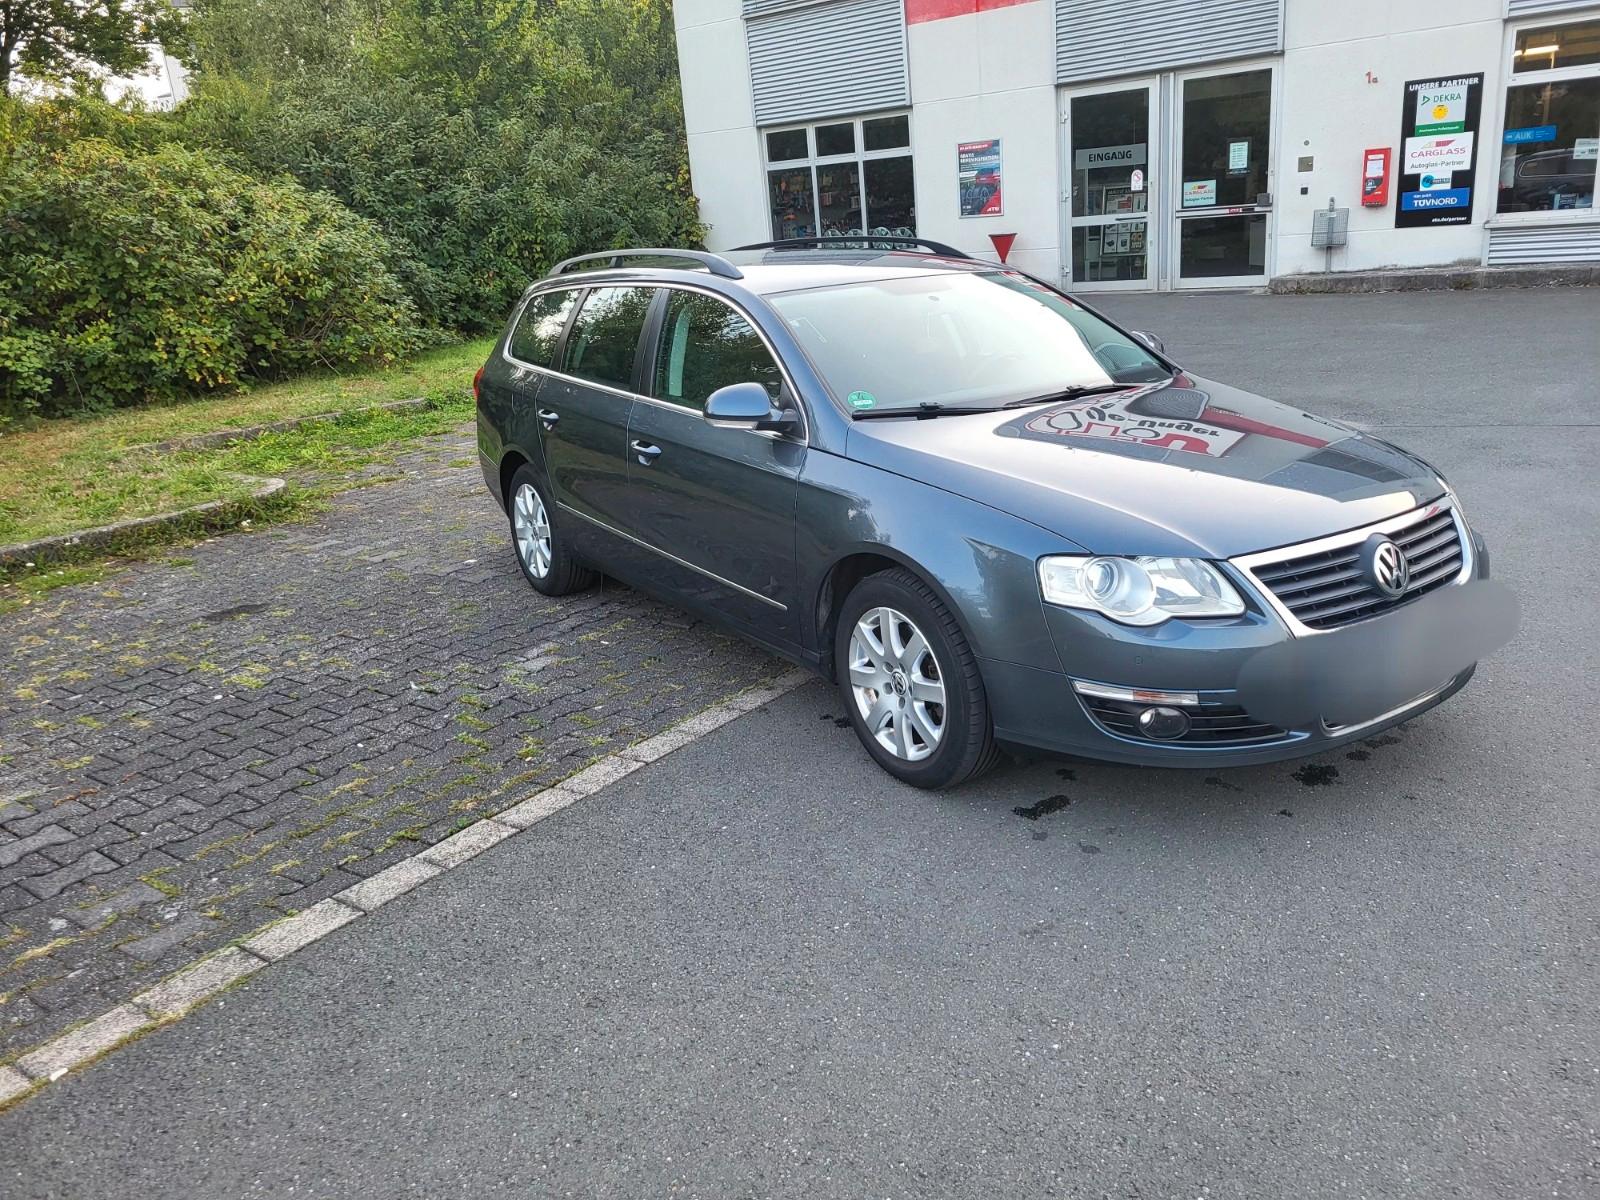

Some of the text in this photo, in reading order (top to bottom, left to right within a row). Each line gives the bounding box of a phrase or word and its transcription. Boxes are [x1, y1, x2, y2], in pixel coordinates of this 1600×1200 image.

[1409, 77, 1479, 91] UNSERE PARTNER
[1433, 93, 1462, 103] DEKRA
[1088, 150, 1133, 162] EINGANG
[1411, 147, 1467, 159] CARGLASS
